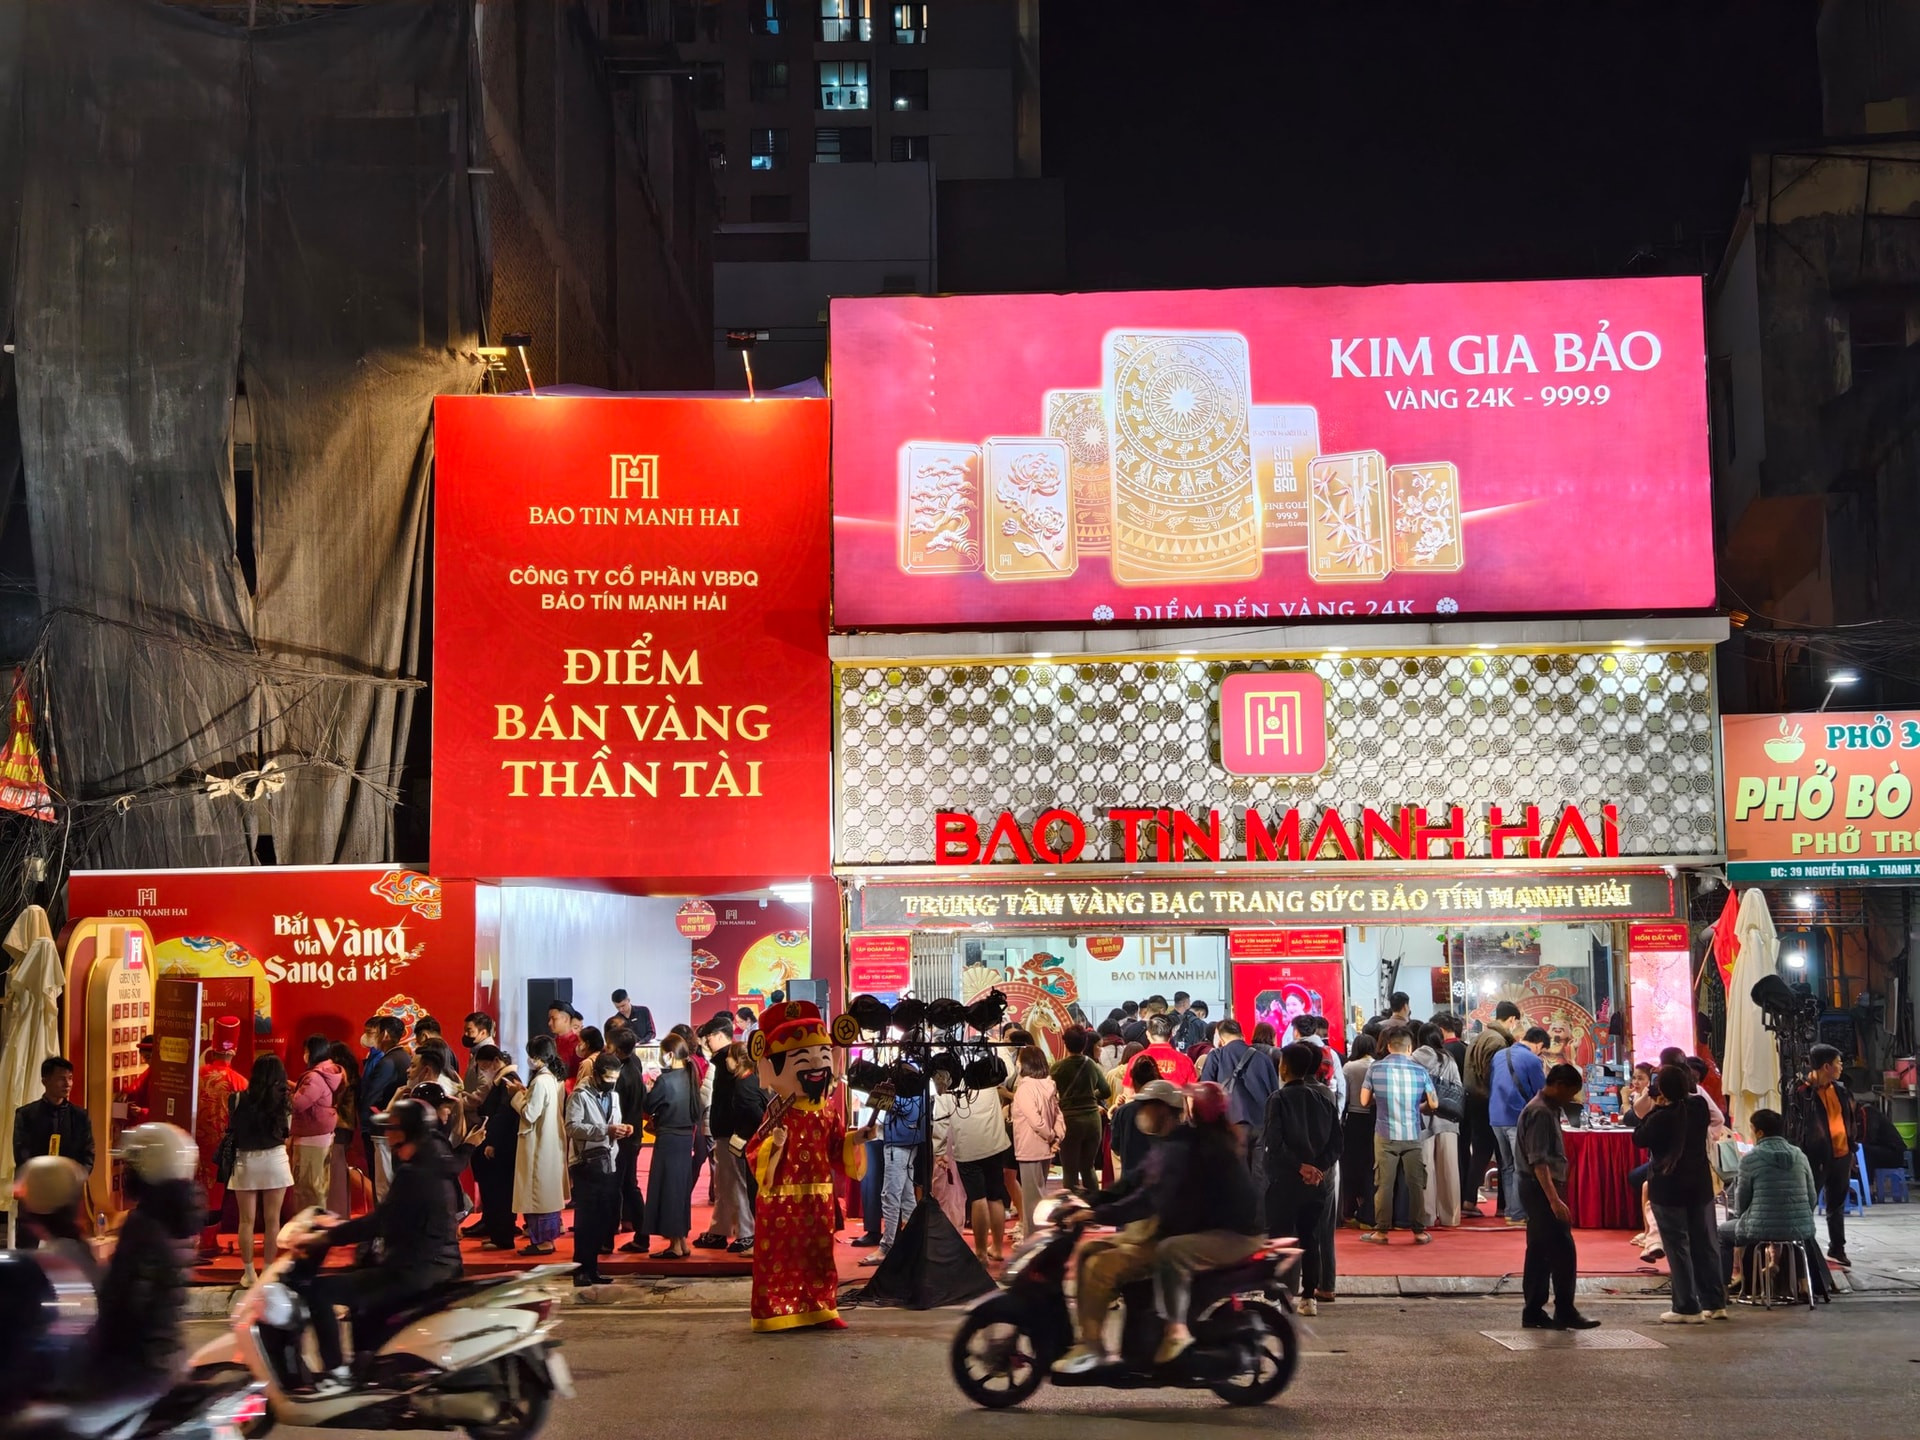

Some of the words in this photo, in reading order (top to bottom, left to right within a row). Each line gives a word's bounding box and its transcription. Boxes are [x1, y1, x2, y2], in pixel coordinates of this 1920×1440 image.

[1330, 336, 1435, 378] KIM
[1448, 334, 1541, 375] GIA
[1553, 319, 1662, 373] BẢO
[1385, 386, 1459, 411] VÀNG
[1465, 387, 1515, 408] 24K
[1540, 385, 1611, 407] 999.9
[529, 506, 576, 525] BAO
[579, 507, 619, 525] TIN
[623, 507, 694, 526] MANH
[699, 508, 739, 526] HAI
[1264, 502, 1284, 510] FINE
[1285, 501, 1309, 510] GOLD
[1276, 512, 1298, 520] 999.9
[509, 564, 569, 586] CÔNG
[574, 569, 599, 586] TY
[604, 564, 635, 586] CỔ
[640, 565, 697, 587] PHẦN
[702, 569, 759, 588] VBĐQ
[541, 589, 585, 610] BẢO
[590, 590, 622, 611] TÍN
[628, 594, 687, 614] MẠNH
[693, 590, 727, 611] HẢI
[562, 632, 703, 685] ĐIỂM
[492, 693, 608, 741] BÁN
[621, 694, 771, 741] VÀNG
[1825, 714, 1893, 750] PHỞ
[501, 744, 661, 797] THẦN
[672, 749, 763, 797] TÀI
[1734, 758, 1837, 821] PHỞ
[1845, 760, 1913, 819] BÒ
[935, 808, 1086, 866] BAO
[1245, 807, 1464, 862] MANH
[1791, 825, 1862, 854] PHỞ
[1871, 829, 1920, 853] TR
[1770, 867, 1787, 877] ĐC:
[1790, 867, 1802, 877] 39
[1805, 863, 1845, 876] NGUYỄN
[1847, 864, 1870, 875] TRÃI
[1879, 864, 1911, 875] THANH
[107, 909, 125, 917] BAO
[143, 908, 170, 916] MANH
[172, 908, 188, 916] HAI
[900, 894, 1000, 917] TRUNG
[1001, 888, 1065, 916] TÂM
[1067, 887, 1146, 915] VÀNG
[1149, 891, 1205, 919] BẠC
[1210, 890, 1303, 913] TRANG
[1310, 884, 1364, 912] SỨC
[1371, 883, 1428, 911] BẢO
[1432, 882, 1483, 911] TÍN
[273, 912, 309, 936] Bắt
[1651, 933, 1665, 941] ĐẤT
[1667, 933, 1682, 941] VIỆT
[293, 936, 321, 955] vía
[313, 917, 408, 961] Vàng
[264, 955, 335, 989] Sang
[337, 959, 357, 982] cả
[364, 958, 388, 981] tết
[1112, 972, 1135, 981] BAO
[1138, 971, 1156, 980] TIN
[1156, 971, 1193, 980] MANH
[1195, 970, 1216, 980] HAI
